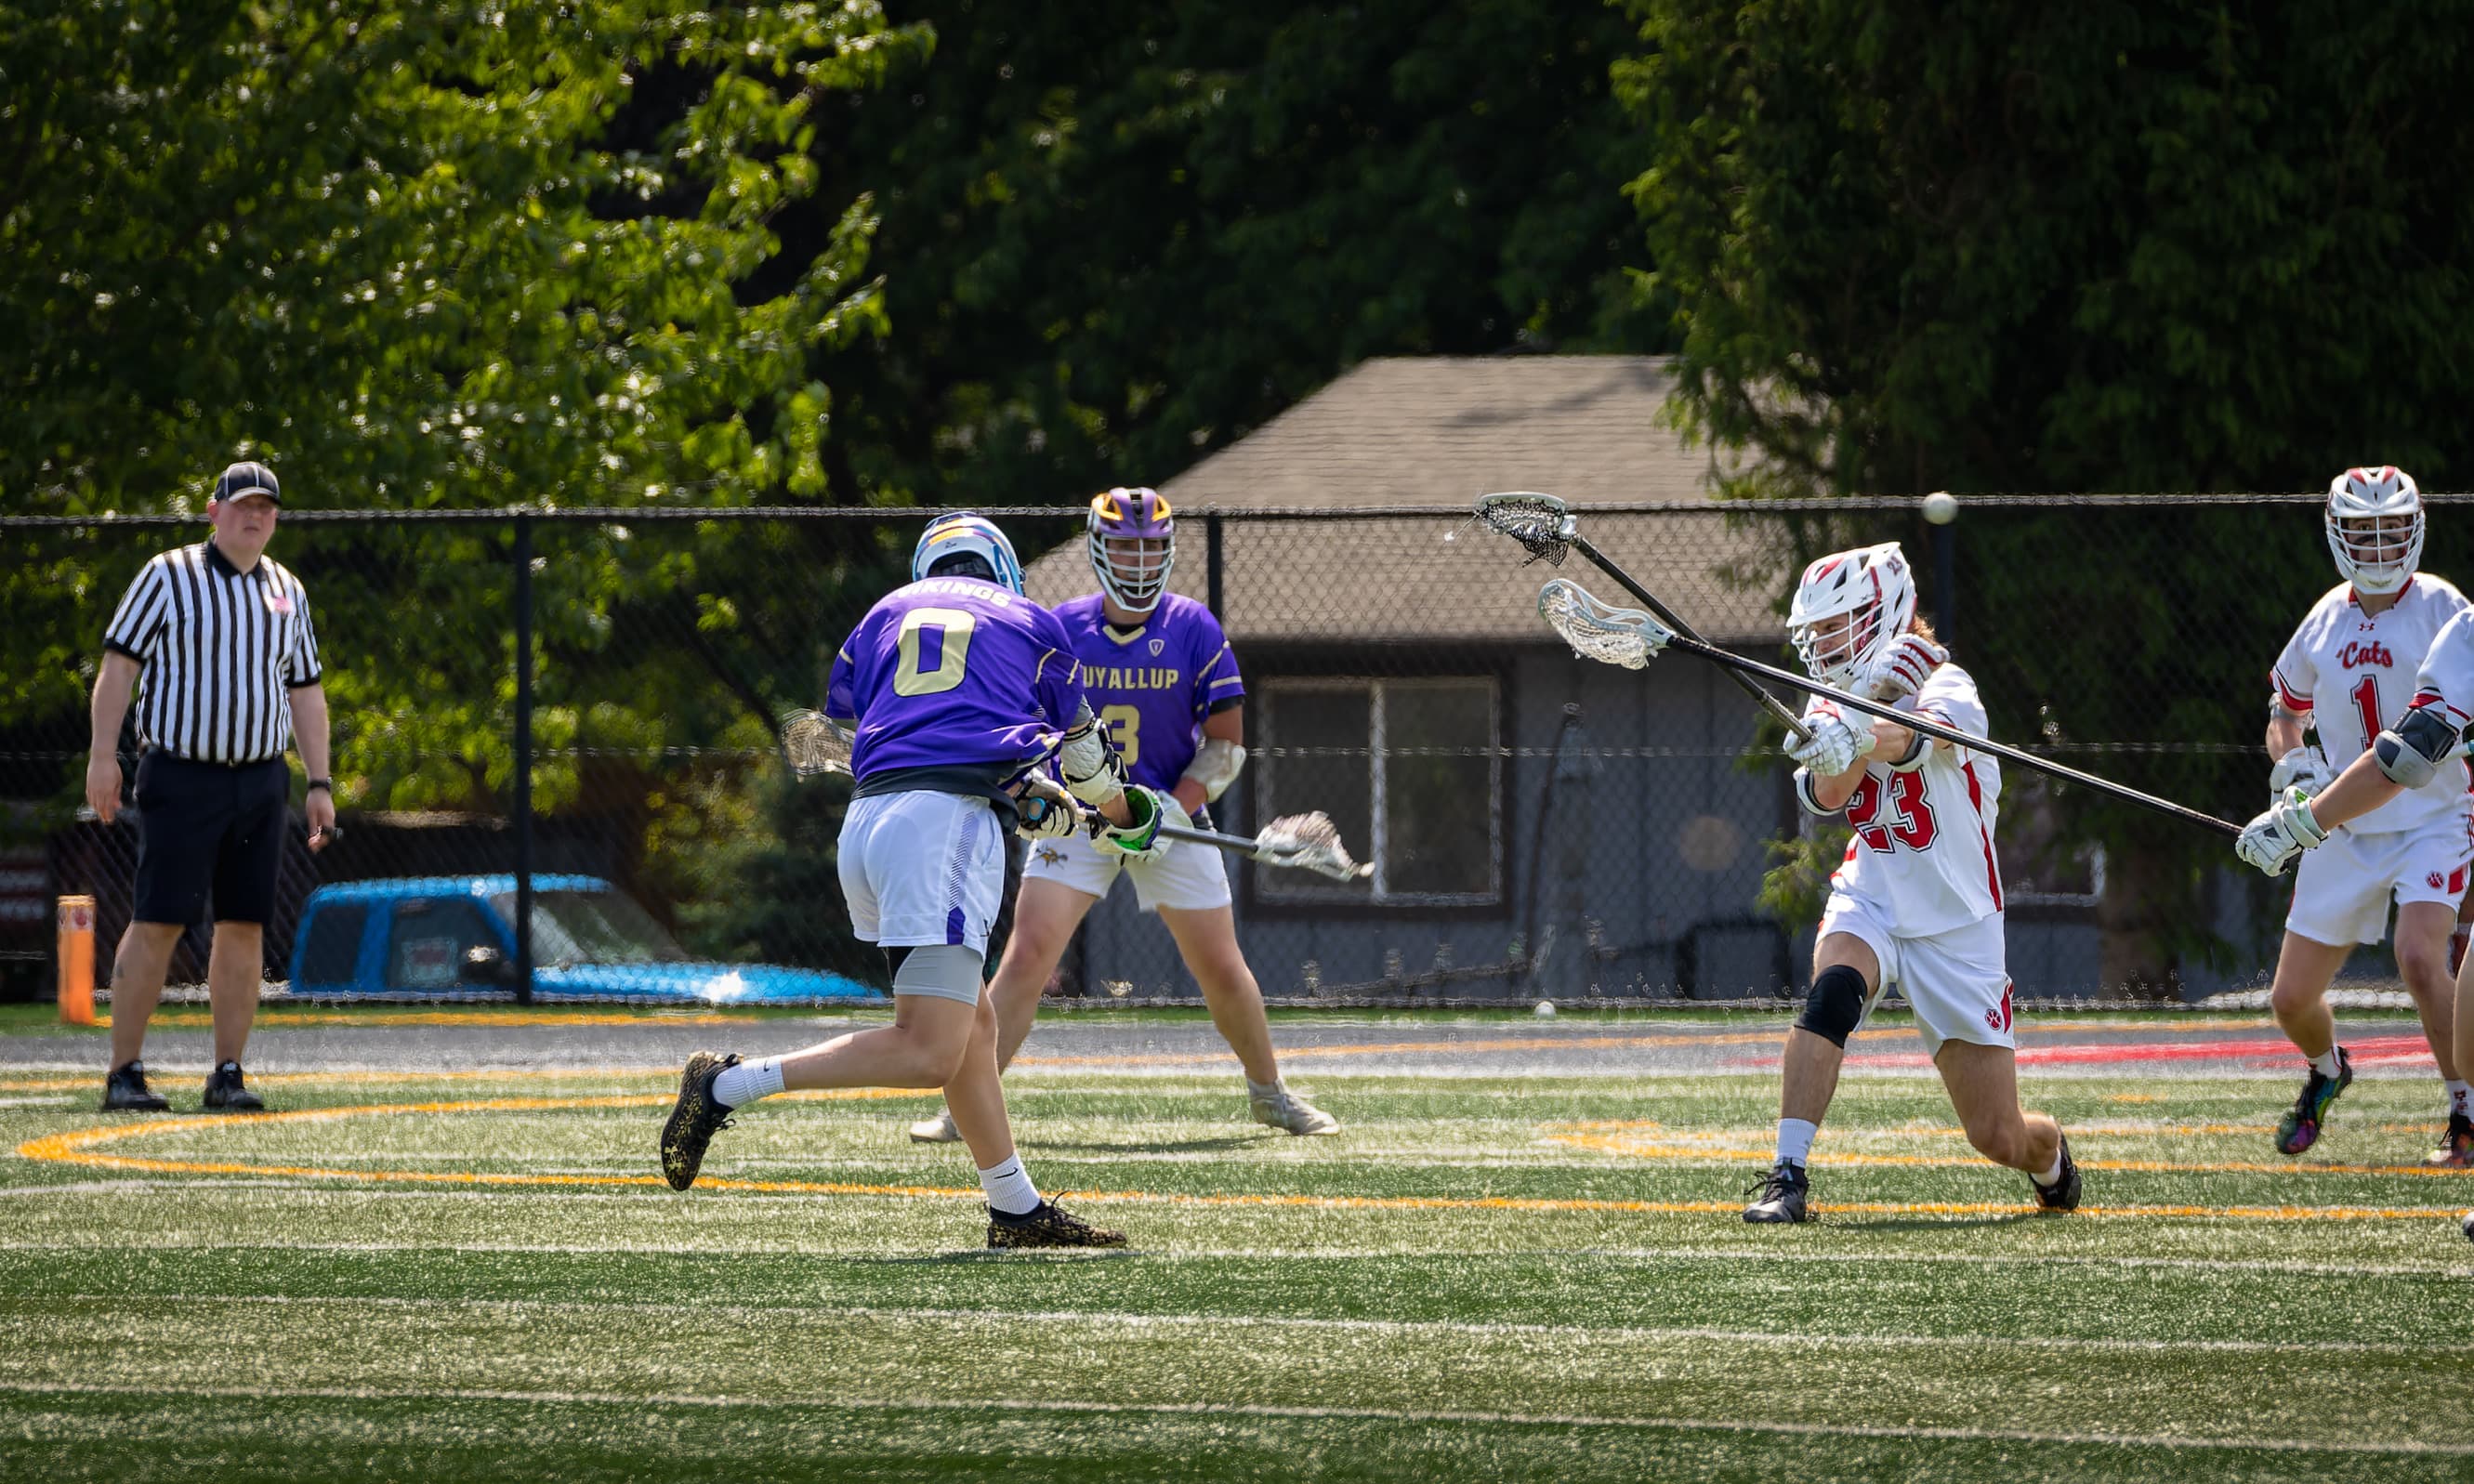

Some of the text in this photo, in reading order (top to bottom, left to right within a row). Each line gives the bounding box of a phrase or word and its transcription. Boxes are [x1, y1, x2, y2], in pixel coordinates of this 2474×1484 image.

[892, 607, 977, 698] 0
[1082, 665, 1179, 689] UYALLUP
[1100, 703, 1139, 767] 3
[2350, 674, 2383, 753] 1
[1845, 764, 1940, 853] 23
